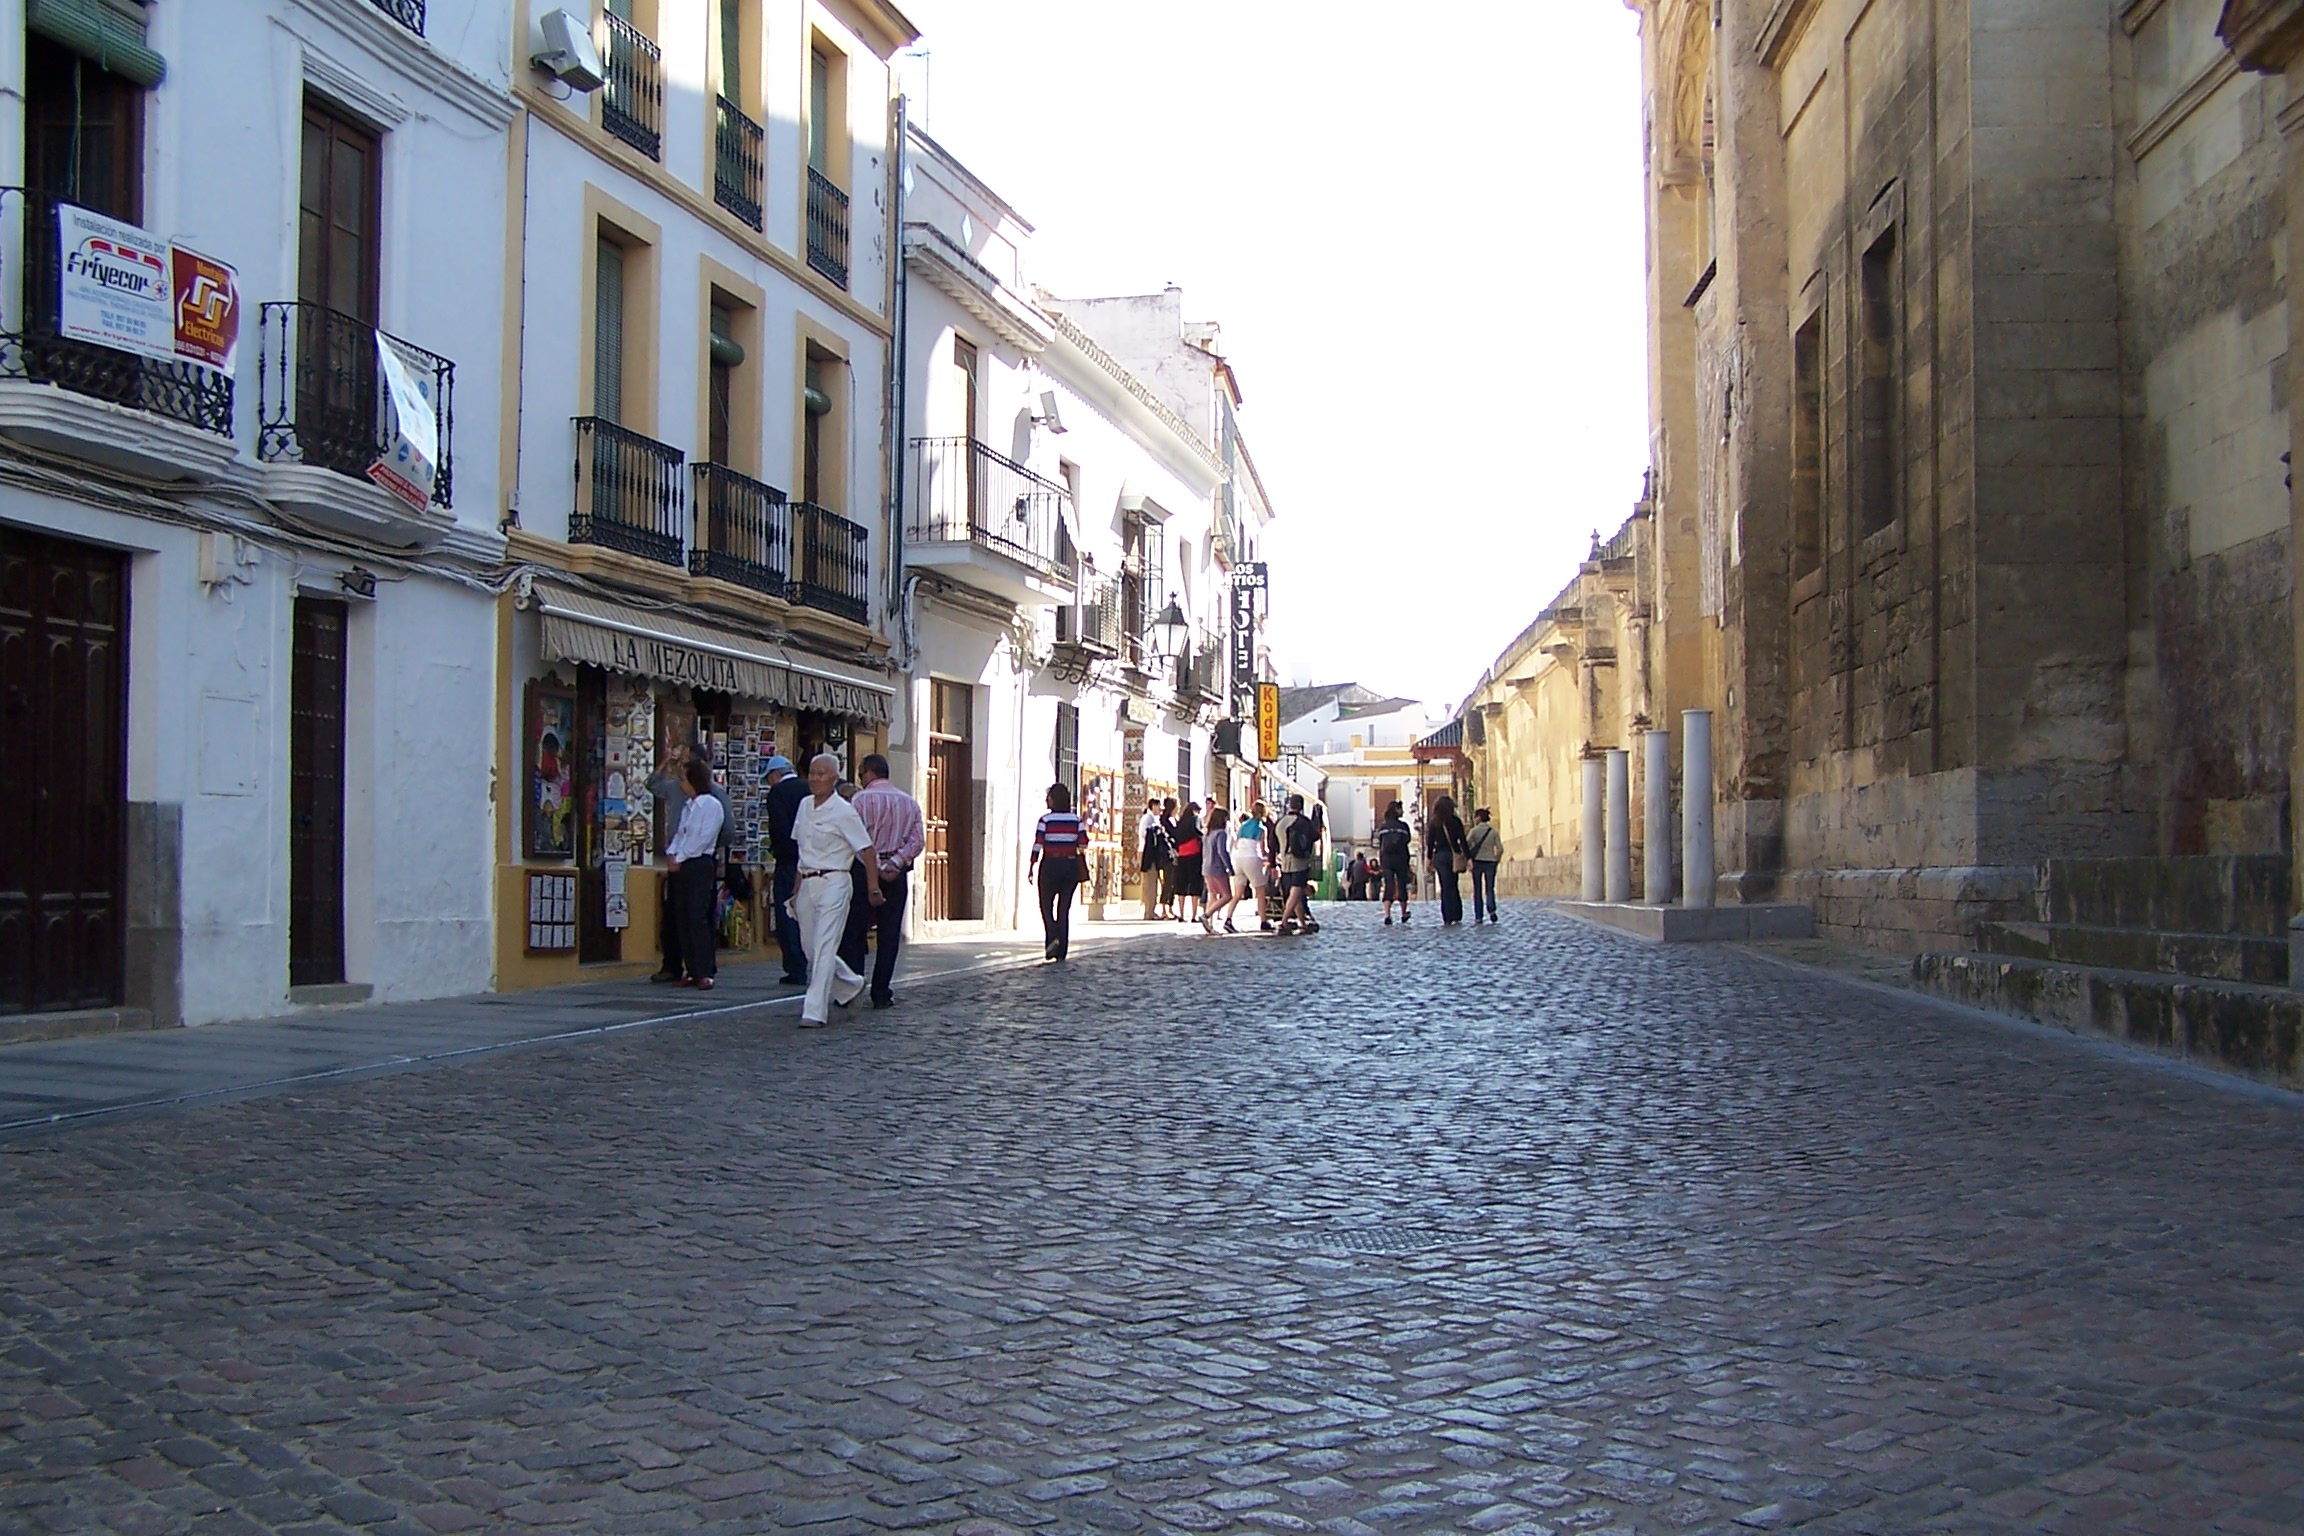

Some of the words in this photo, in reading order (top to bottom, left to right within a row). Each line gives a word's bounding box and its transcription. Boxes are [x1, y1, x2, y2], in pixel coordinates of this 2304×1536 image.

[1232, 574, 1265, 586] TIOS
[1233, 563, 1255, 575] OS
[612, 634, 639, 670] LA
[649, 642, 737, 690] MEZQUITA
[1238, 590, 1250, 689] HOTE
[800, 676, 818, 703] LA
[821, 683, 887, 719] MEZQUITA
[1263, 687, 1273, 757] Kodak
